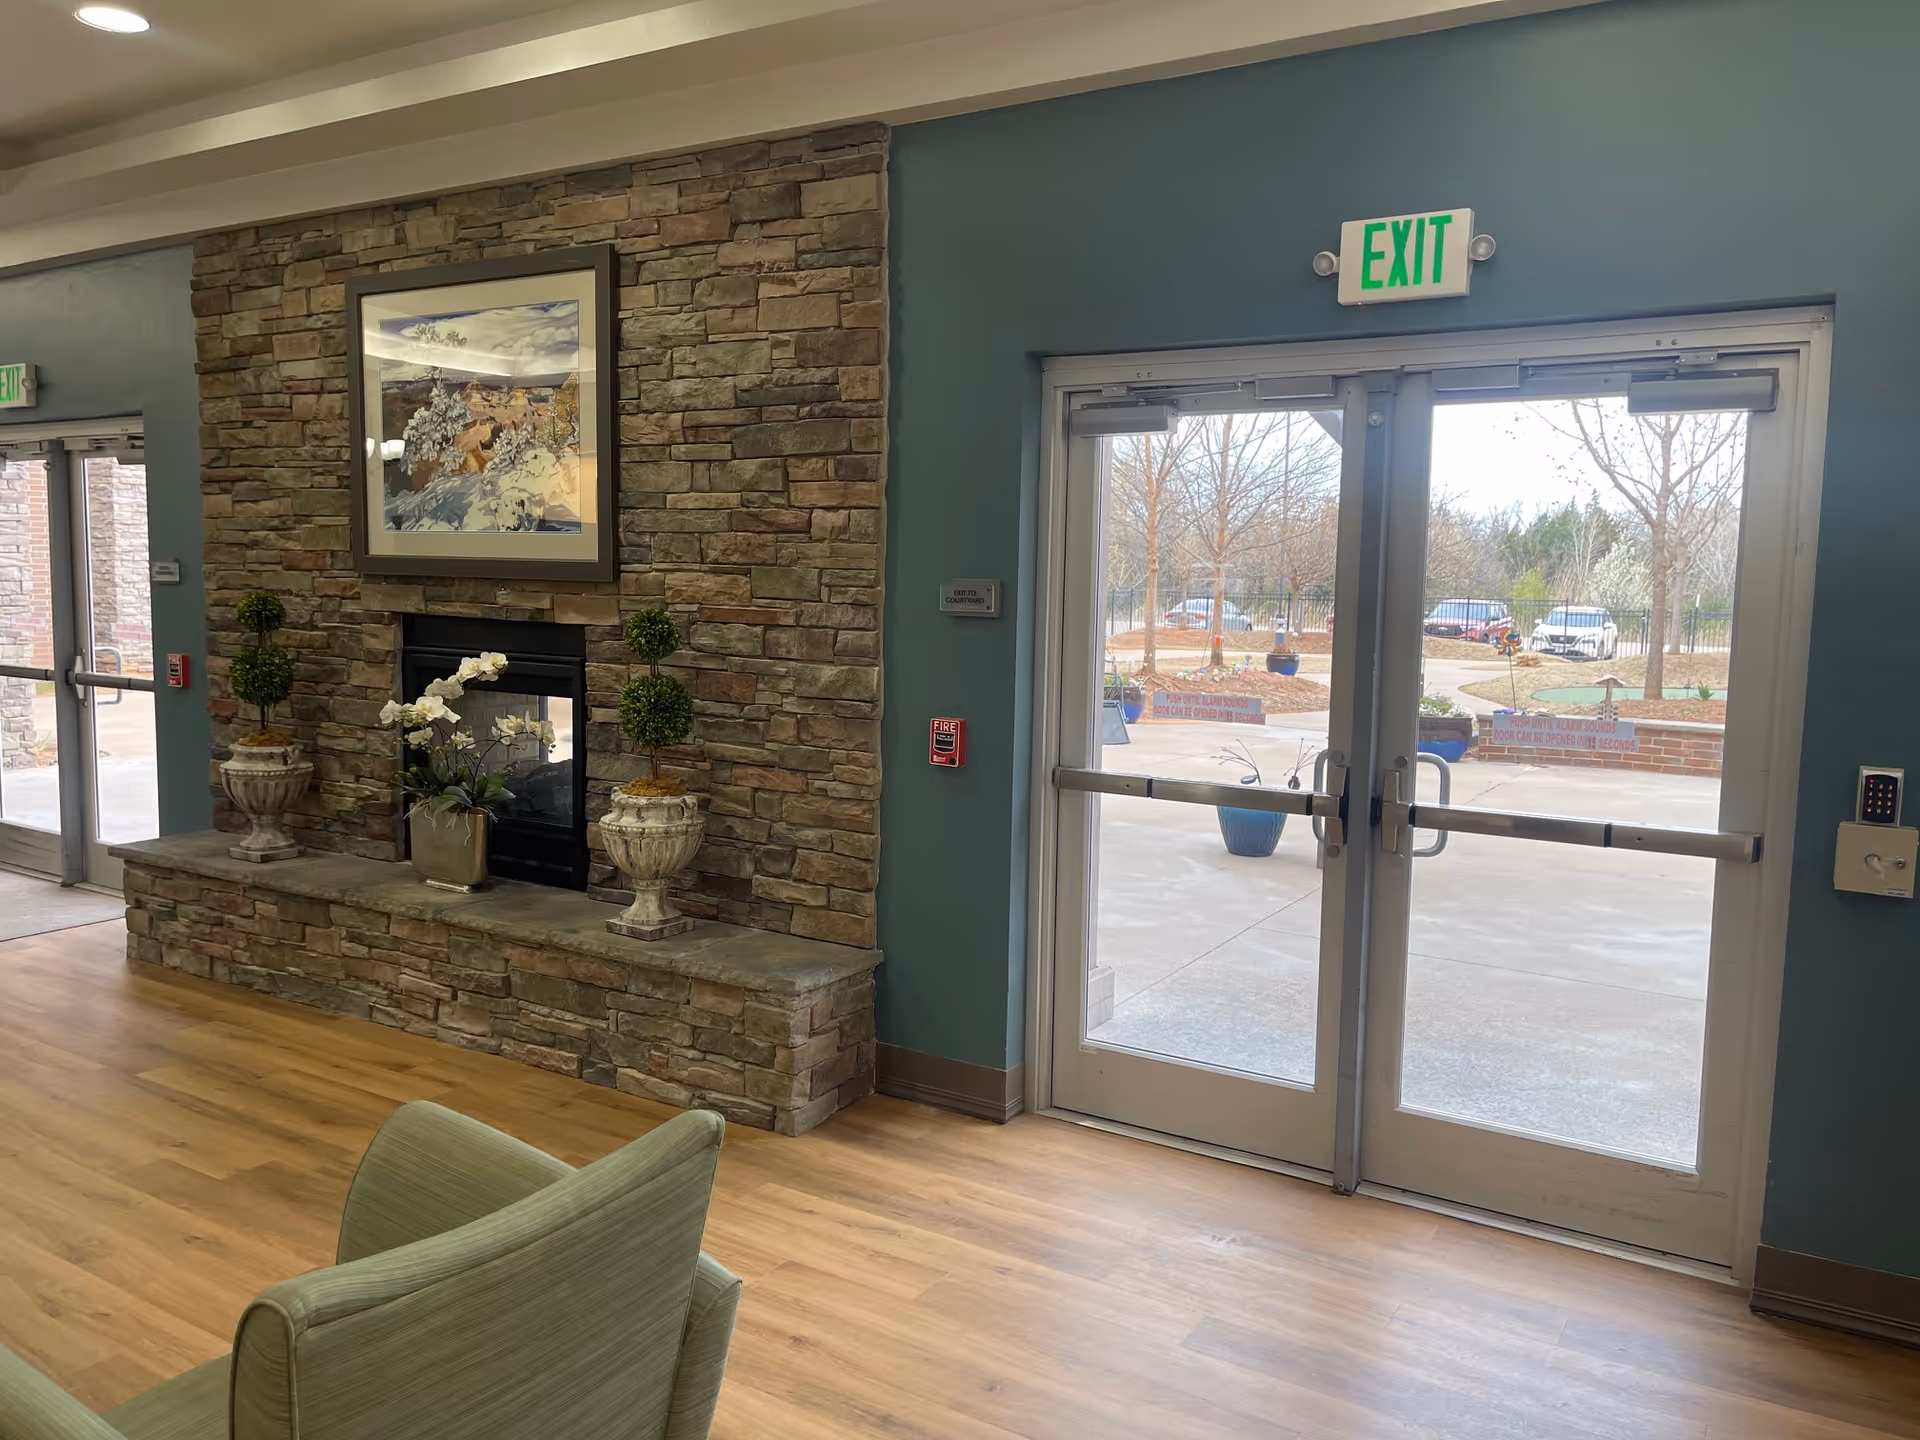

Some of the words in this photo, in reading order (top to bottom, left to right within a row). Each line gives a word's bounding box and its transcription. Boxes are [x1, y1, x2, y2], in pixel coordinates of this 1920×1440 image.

[1362, 215, 1452, 289] EXIT
[1166, 694, 1182, 704] PUSH
[1183, 695, 1200, 705] UNTIL
[1202, 695, 1222, 707] ALARM
[1223, 697, 1249, 709] SOUNDS
[1153, 705, 1170, 715] DOOR
[1171, 706, 1183, 716] CAN
[1184, 707, 1192, 717] BE
[1193, 707, 1217, 719] OPENED
[1218, 709, 1225, 720] IN
[934, 720, 956, 733] FIRE
[1510, 718, 1530, 729] PUSH
[1532, 719, 1553, 731] UNTIL
[1556, 719, 1583, 732] ALARM
[1584, 721, 1617, 735] SOUNDS
[1494, 729, 1514, 741] DOOR
[1516, 730, 1532, 742] CAN
[1534, 732, 1543, 743] BE
[1545, 732, 1576, 746] OPENED
[1577, 734, 1586, 747] IN
